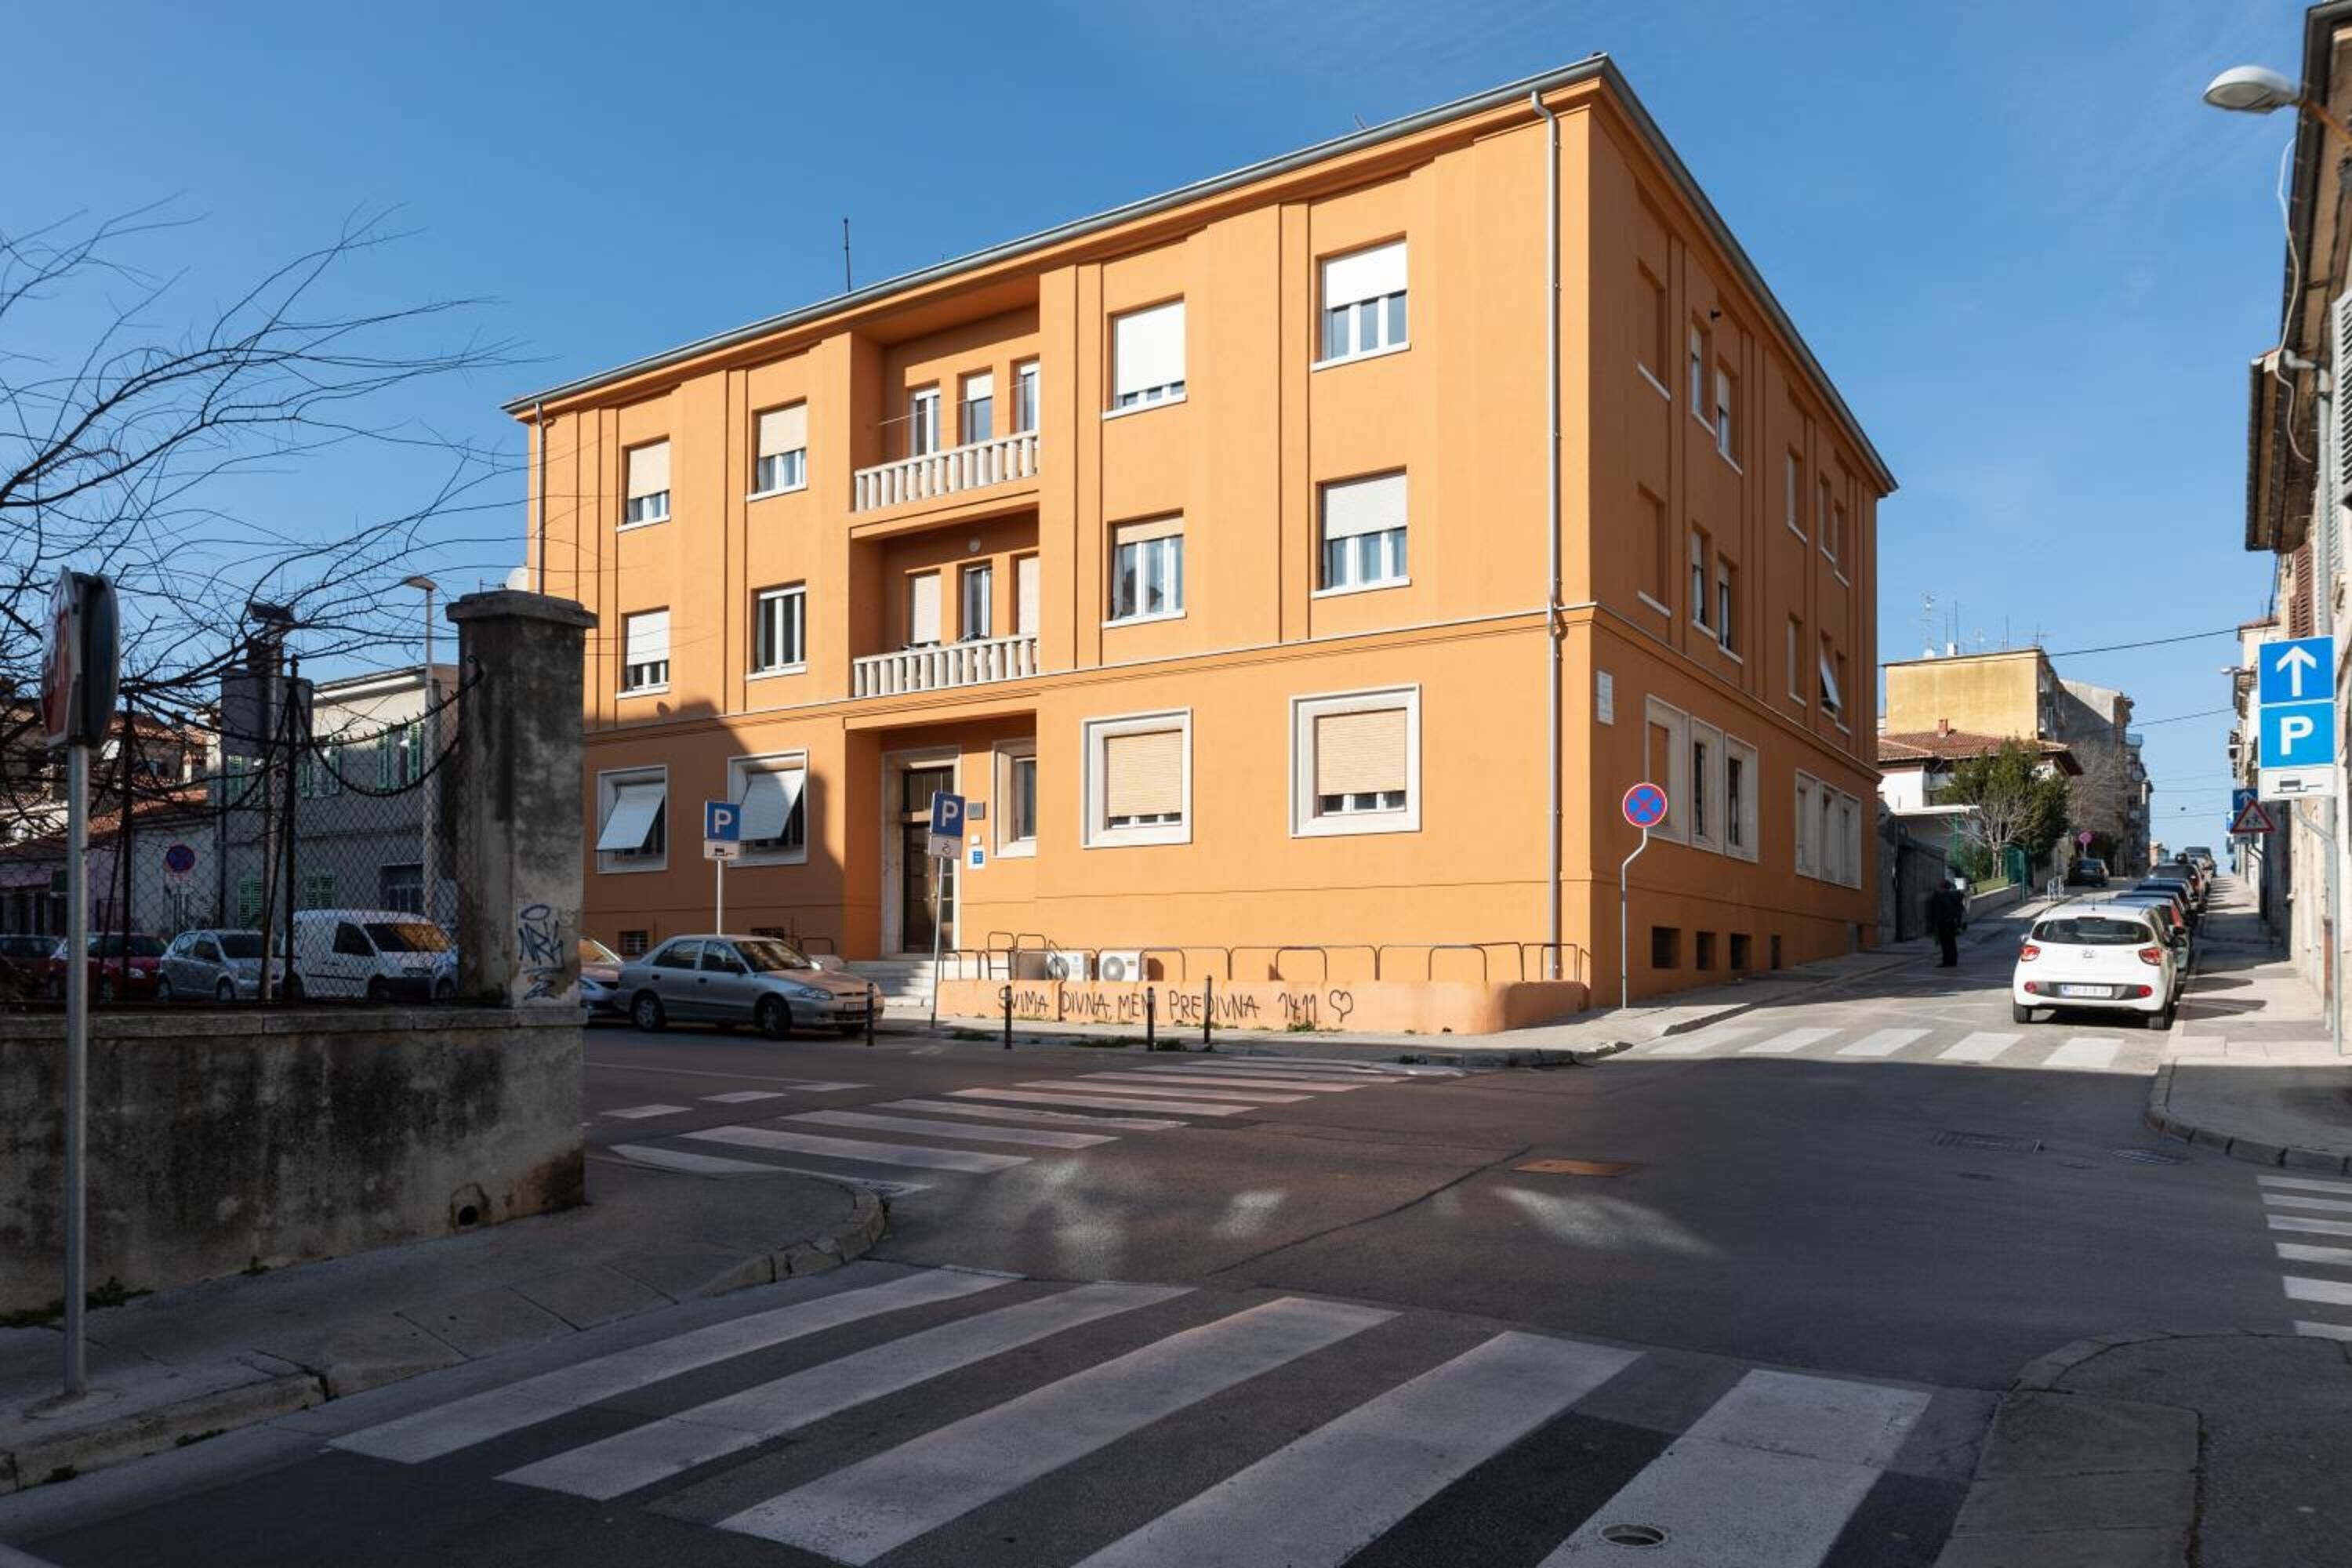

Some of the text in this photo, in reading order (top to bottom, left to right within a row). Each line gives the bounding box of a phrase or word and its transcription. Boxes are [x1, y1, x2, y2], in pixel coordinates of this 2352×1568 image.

[2281, 716, 2314, 756] P
[715, 809, 732, 833] P
[942, 800, 959, 827] P
